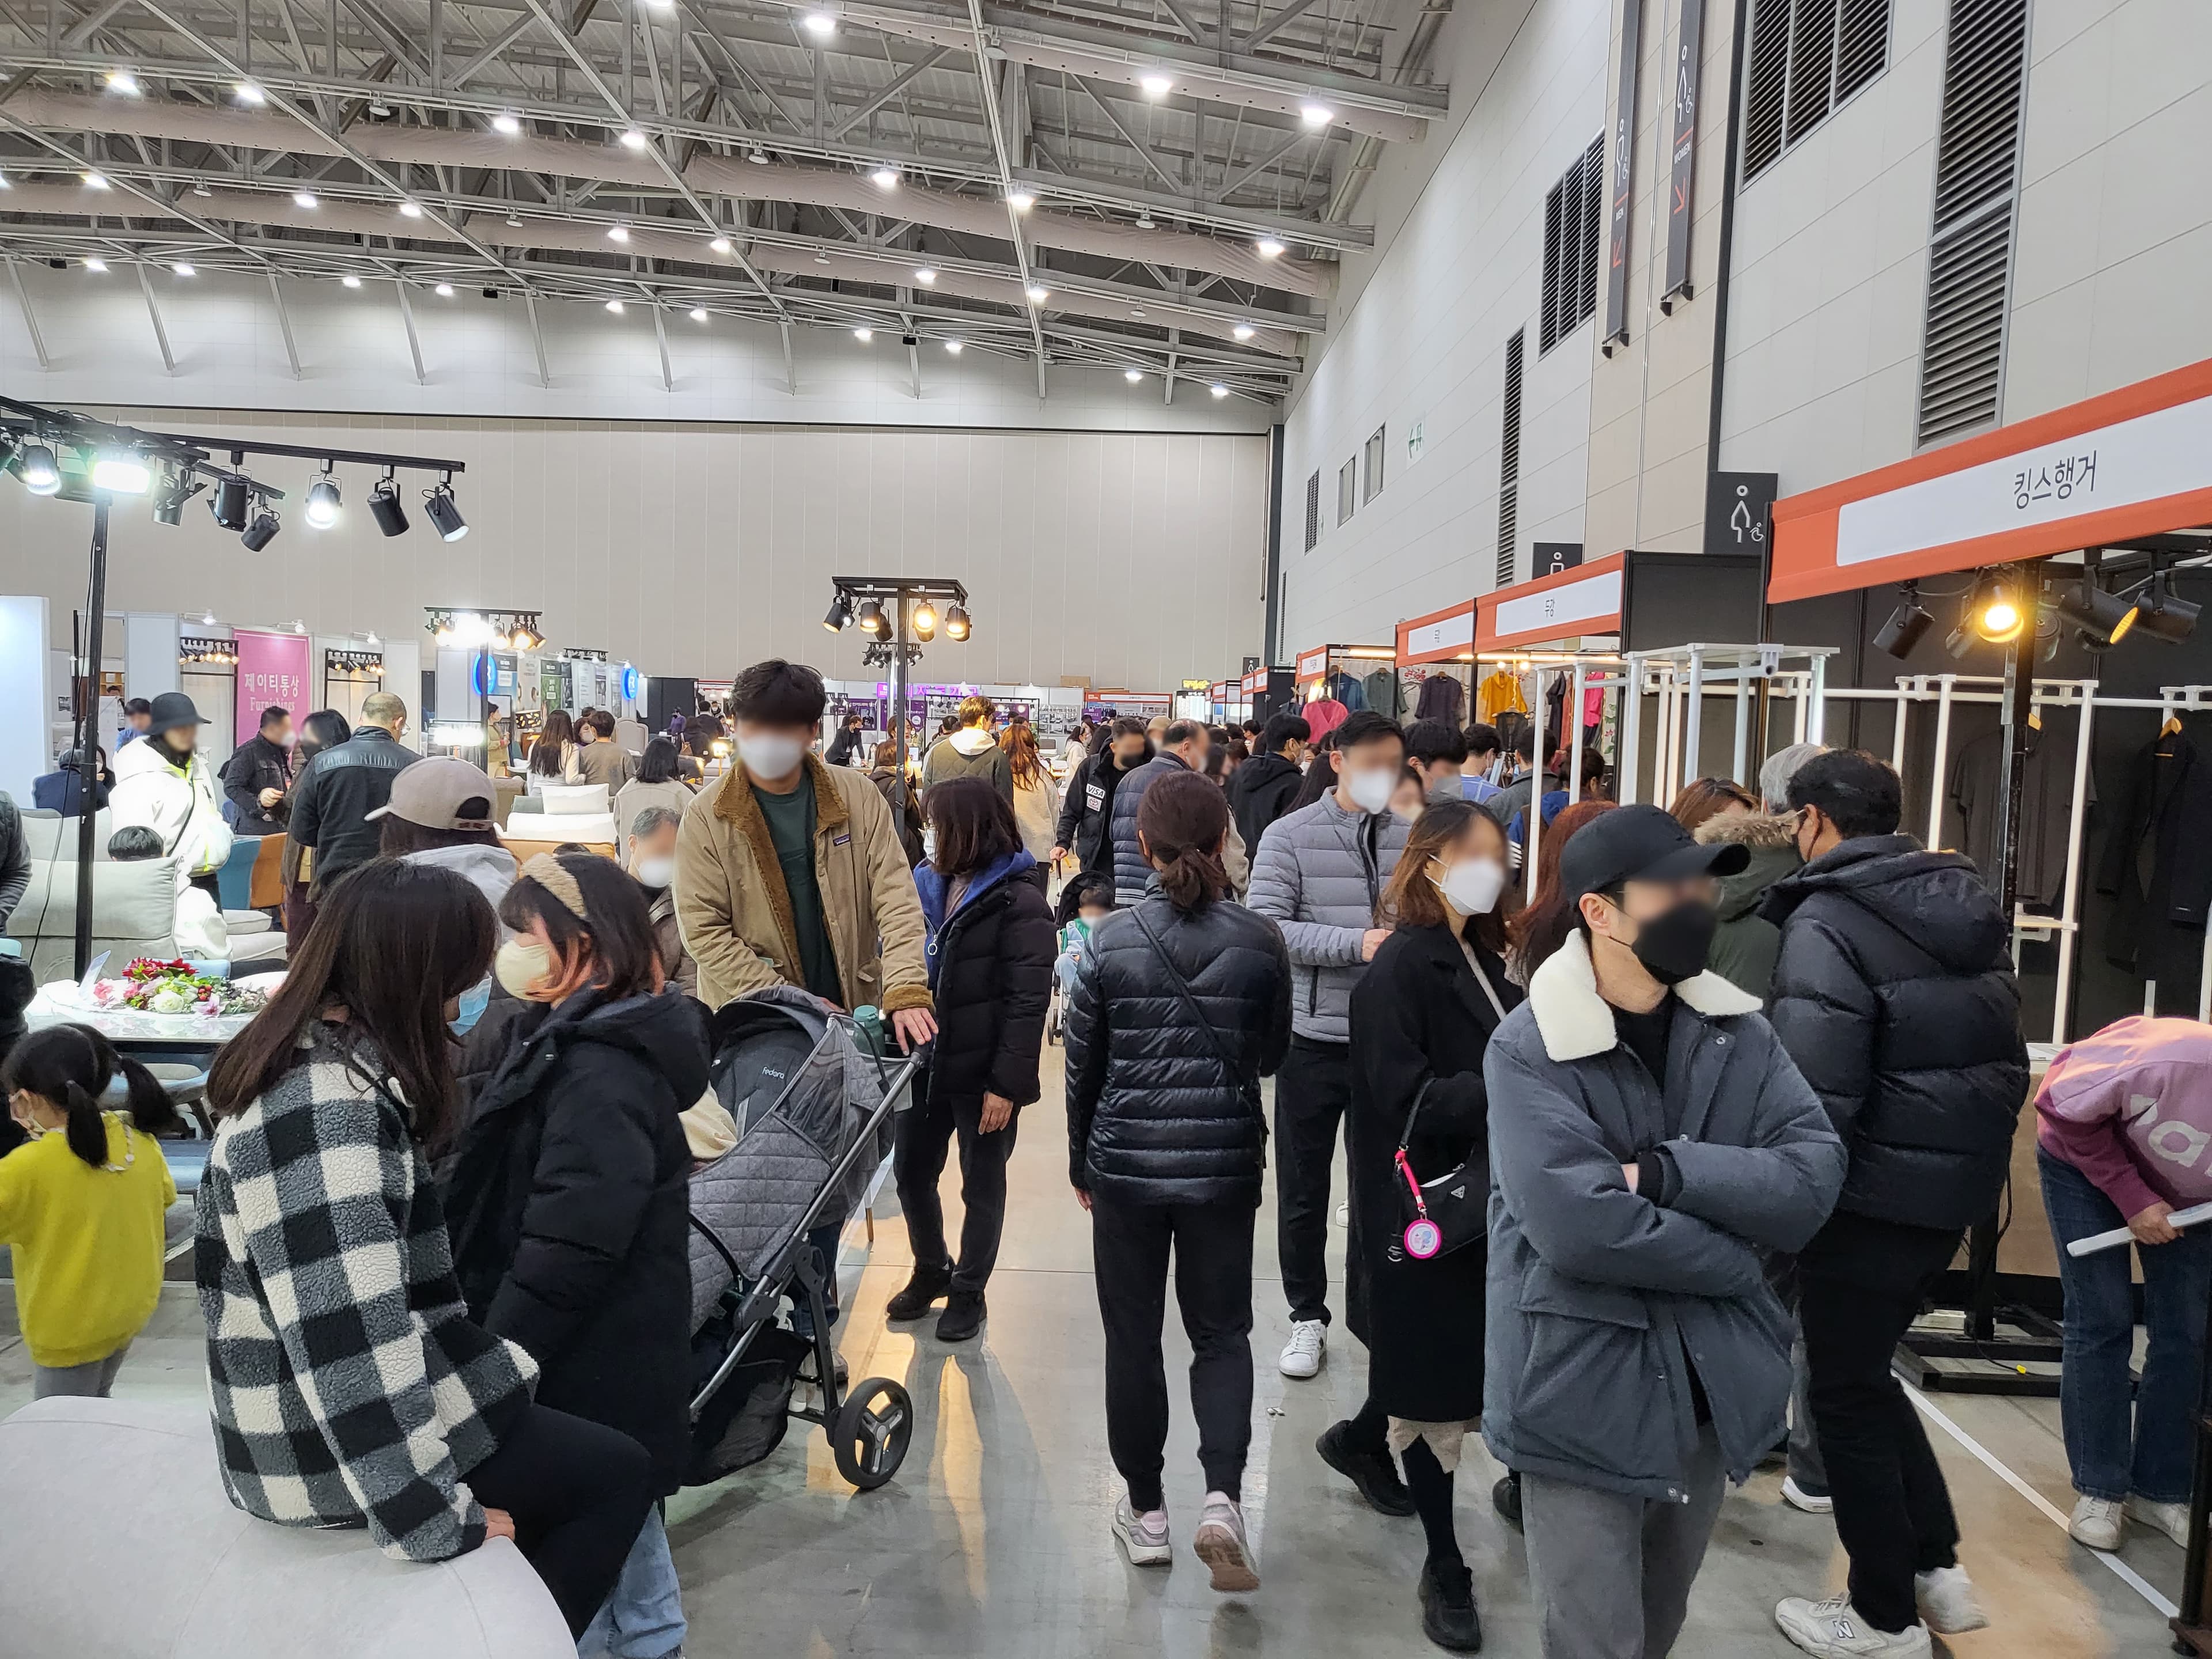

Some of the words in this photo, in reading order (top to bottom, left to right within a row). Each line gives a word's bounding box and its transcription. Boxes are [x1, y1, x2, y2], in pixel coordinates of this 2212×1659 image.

[1674, 140, 1691, 165] WOMEN
[1616, 206, 1624, 222] MEN
[2014, 449, 2097, 509] 킹스행거
[1544, 598, 1555, 618] 두강
[244, 673, 300, 698] 제이티통상
[1088, 785, 1104, 798] VISA
[762, 1066, 785, 1079] fedora
[1833, 1620, 1855, 1638] N
